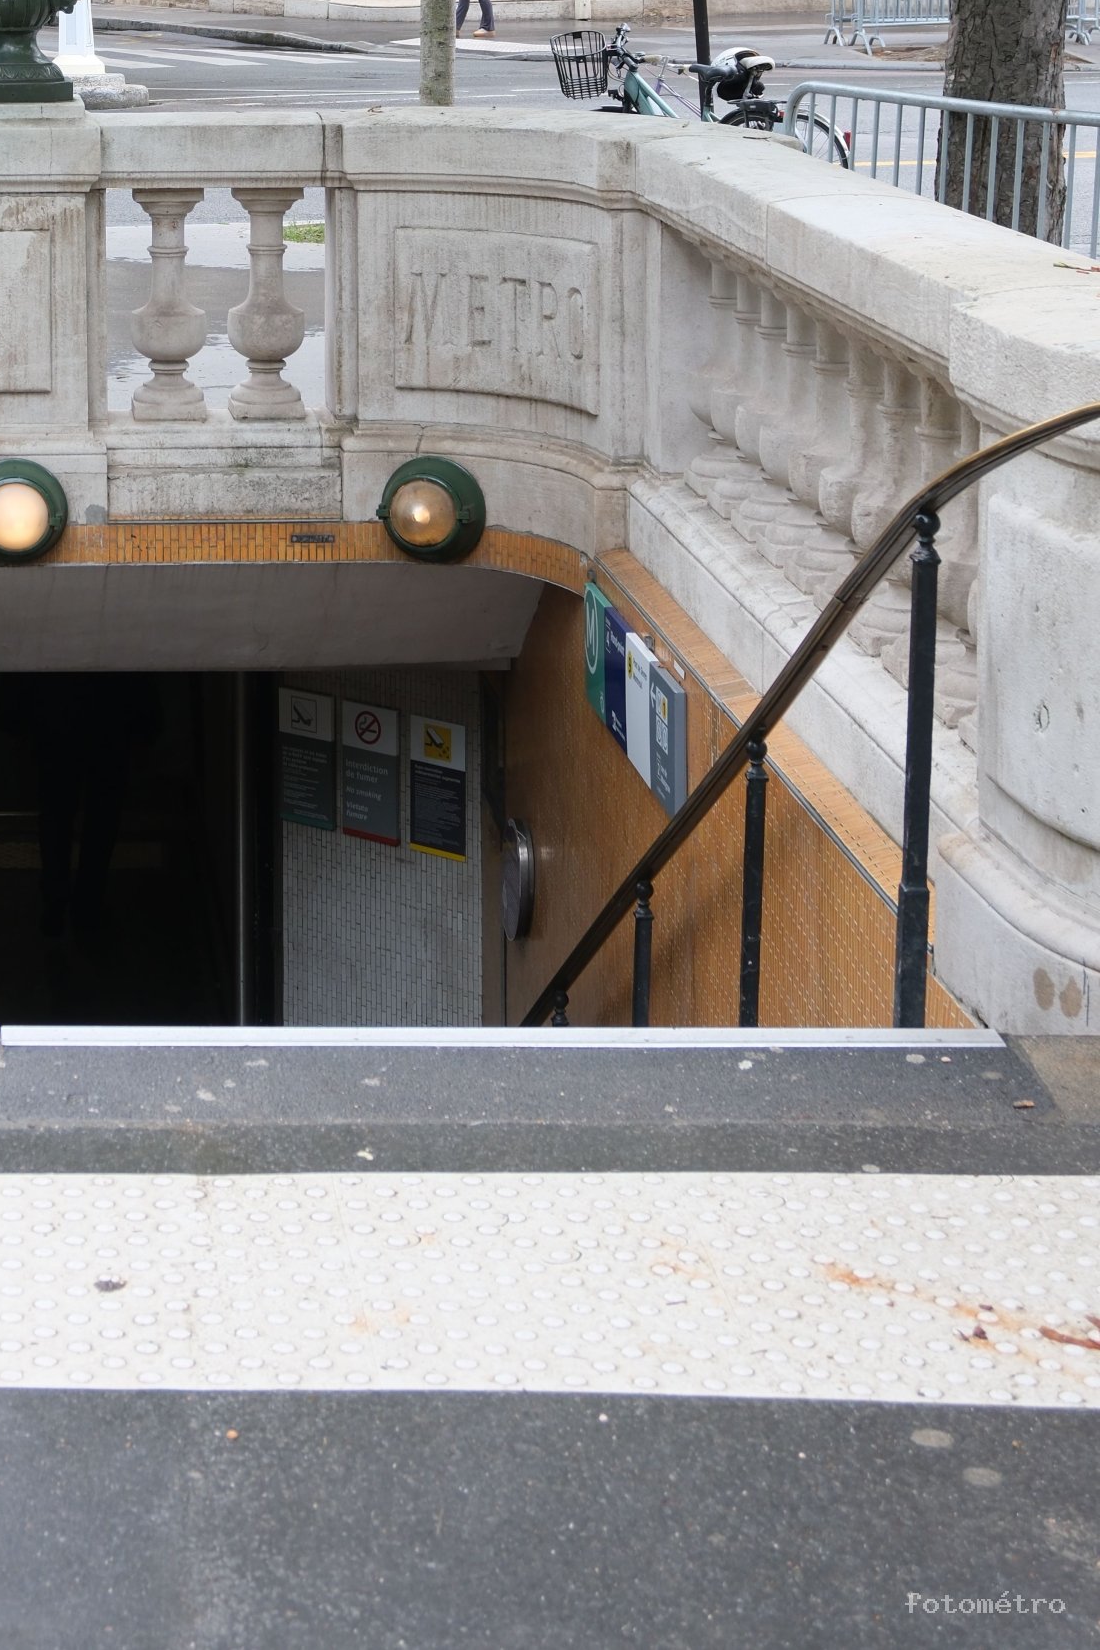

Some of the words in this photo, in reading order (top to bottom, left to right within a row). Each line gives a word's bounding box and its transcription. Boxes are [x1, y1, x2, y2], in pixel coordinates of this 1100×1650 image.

[404, 271, 585, 360] METRO
[345, 758, 388, 776] Interdiction
[356, 771, 378, 783] fumer
